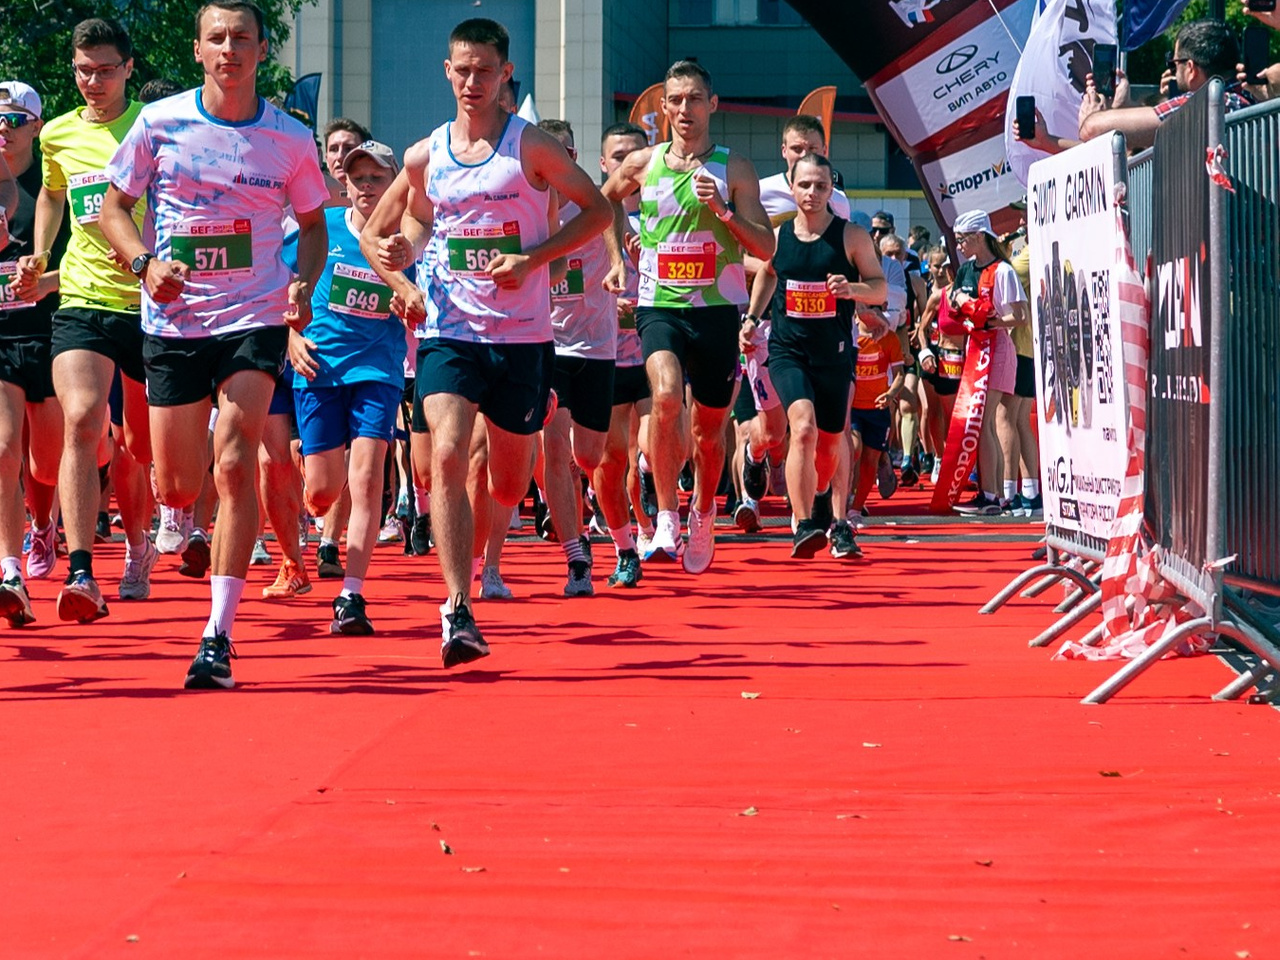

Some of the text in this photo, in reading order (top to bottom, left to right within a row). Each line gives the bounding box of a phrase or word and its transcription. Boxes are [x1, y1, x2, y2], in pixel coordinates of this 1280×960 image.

[933, 51, 1000, 100] CHERY
[947, 71, 1008, 113] ВИП АВТО
[83, 193, 106, 214] 59
[190, 225, 211, 235] БЕГ
[463, 228, 482, 237] БЕГ
[195, 247, 228, 270] 571
[351, 270, 369, 279] БЕГ
[667, 261, 705, 279] 3297
[346, 288, 380, 311] 649
[795, 298, 826, 312] 3130
